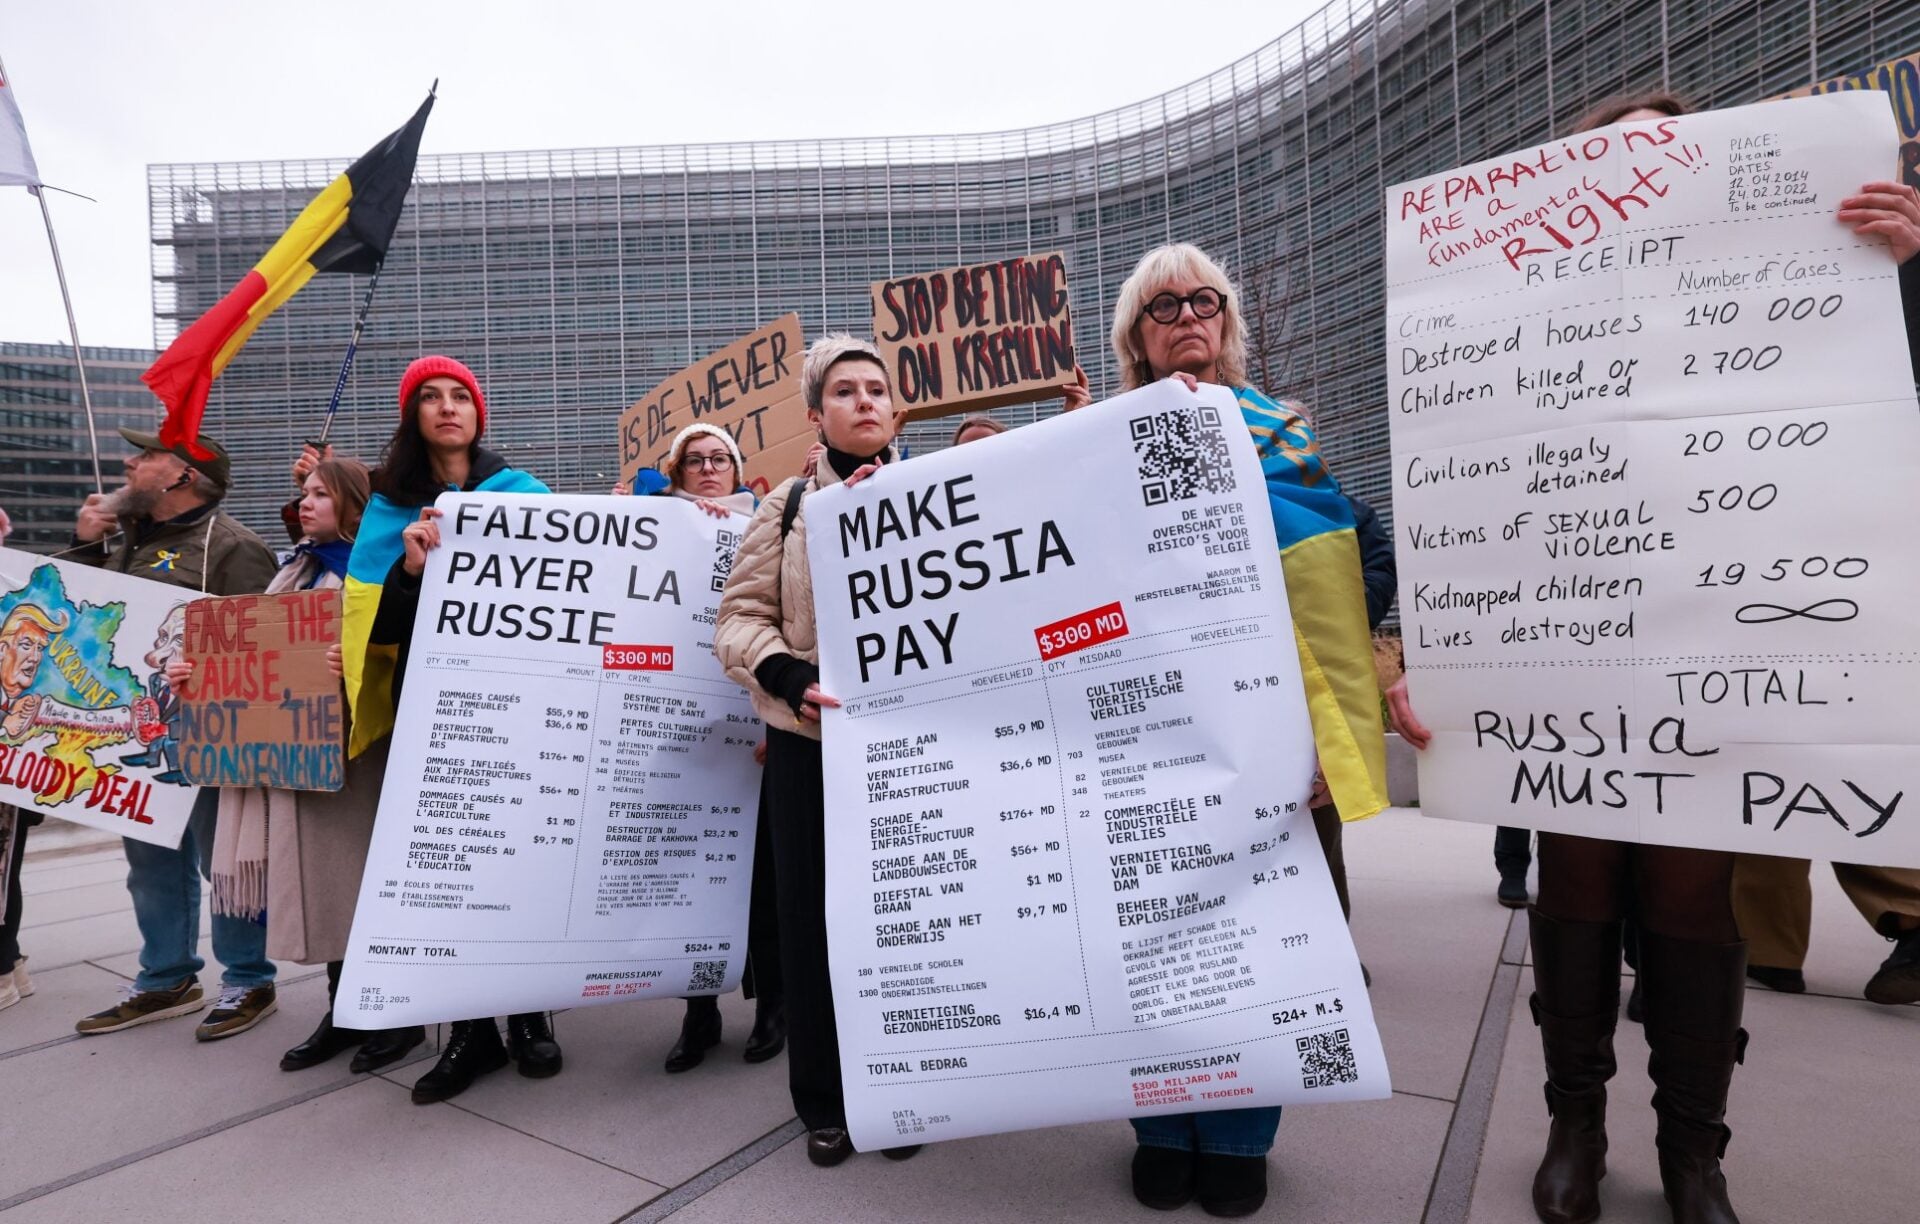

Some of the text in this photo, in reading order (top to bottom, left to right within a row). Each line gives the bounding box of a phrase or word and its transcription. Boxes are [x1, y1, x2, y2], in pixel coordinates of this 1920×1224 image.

[1729, 194, 1817, 212] To be continued
[1419, 198, 1520, 244] ARE a
[1502, 167, 1669, 271] Right
[1678, 260, 1841, 291] Number of Cases
[882, 255, 1067, 342] STOP BETTING
[1400, 313, 1456, 337] Crime
[1403, 295, 1842, 375] Destroyed houses 140 000
[898, 320, 1074, 404] ON KREMLIN
[1401, 346, 1782, 413] Children killed or 2 700
[1537, 377, 1632, 410] injured
[623, 416, 640, 465] IS
[648, 389, 676, 447] DE
[687, 331, 789, 418] WEVER
[1407, 422, 1828, 488] Civilians illegaly 20 000
[1527, 459, 1628, 494] detained
[838, 474, 979, 558] MAKE
[1182, 503, 1243, 520] DE WEVER
[1409, 523, 1487, 550] Victims
[1688, 484, 1777, 513] 500
[456, 503, 659, 551] FAISONS
[1153, 515, 1246, 539] OVERSCHAT DE
[1218, 528, 1248, 541] VOOR
[1205, 538, 1251, 556] BELGIË
[447, 551, 681, 605] PAYER LA
[848, 520, 1075, 619] RUSSIA
[1207, 565, 1257, 579] WAAROM DE
[1135, 574, 1259, 602] HERSTELBETALINGSLENING
[1199, 583, 1261, 600] CRUCIAAL IS
[1415, 557, 1868, 616] Kidnapped children 19 500
[185, 592, 336, 654] FACE THE
[436, 600, 672, 665] RUSSIE $300 MD
[1420, 612, 1634, 649] Lives destroyed
[857, 612, 1125, 683] PAY $300 MD
[1048, 624, 1259, 672] QTY MISDAAD HOEVEELHEID
[49, 633, 120, 708] UKRAINE
[447, 658, 470, 666] CRIME
[566, 667, 595, 677] AMOUNT
[439, 690, 520, 703] DOMMAGES CAUSÉS
[847, 668, 1033, 715] QTY MISDAAD HOEVEELHEID
[1086, 670, 1278, 698] CULTURELE EN $6,9 MD
[1088, 682, 1184, 709] TOERISTISCHE
[41, 704, 68, 718] Made
[86, 712, 113, 723] China
[181, 700, 248, 744] NOT
[435, 708, 474, 717] HABITÉS
[437, 700, 589, 719] AUX IMMEUBLES $55,9 MD
[1091, 702, 1146, 721] VERLIES
[867, 720, 1044, 753] SCHADE AAN $55,9 MD
[1095, 716, 1193, 741] VERNIELDE CULTURELE
[867, 747, 924, 763] WONINGEN
[1068, 737, 1138, 759] 703 GEBOUWEN
[868, 755, 1052, 781] VERNIETIGING $36,6 MD
[85, 768, 153, 825] DEAL
[868, 781, 889, 792] VAN
[868, 780, 969, 804] INFRASTRUCTUUR
[1511, 760, 1904, 838] MUST PAY
[414, 826, 573, 845] VOL DES CÉRÉALES $9,7 MD
[369, 943, 730, 957] MONTANT TOTAL $524+ MD
[586, 970, 663, 980] #MAKERUSSIAPAY
[867, 998, 1344, 1075] TOTAAL BEDRAG 524+ M.$
[1130, 1053, 1241, 1077] #MAKERUSSIAPAY
[1132, 1071, 1237, 1091] $300 MILJARD VAN
[1134, 1087, 1186, 1100] BEVROREN
[1136, 1087, 1254, 1107] RUSSISCHE TEGOEDEN
[893, 1110, 915, 1119] DATA
